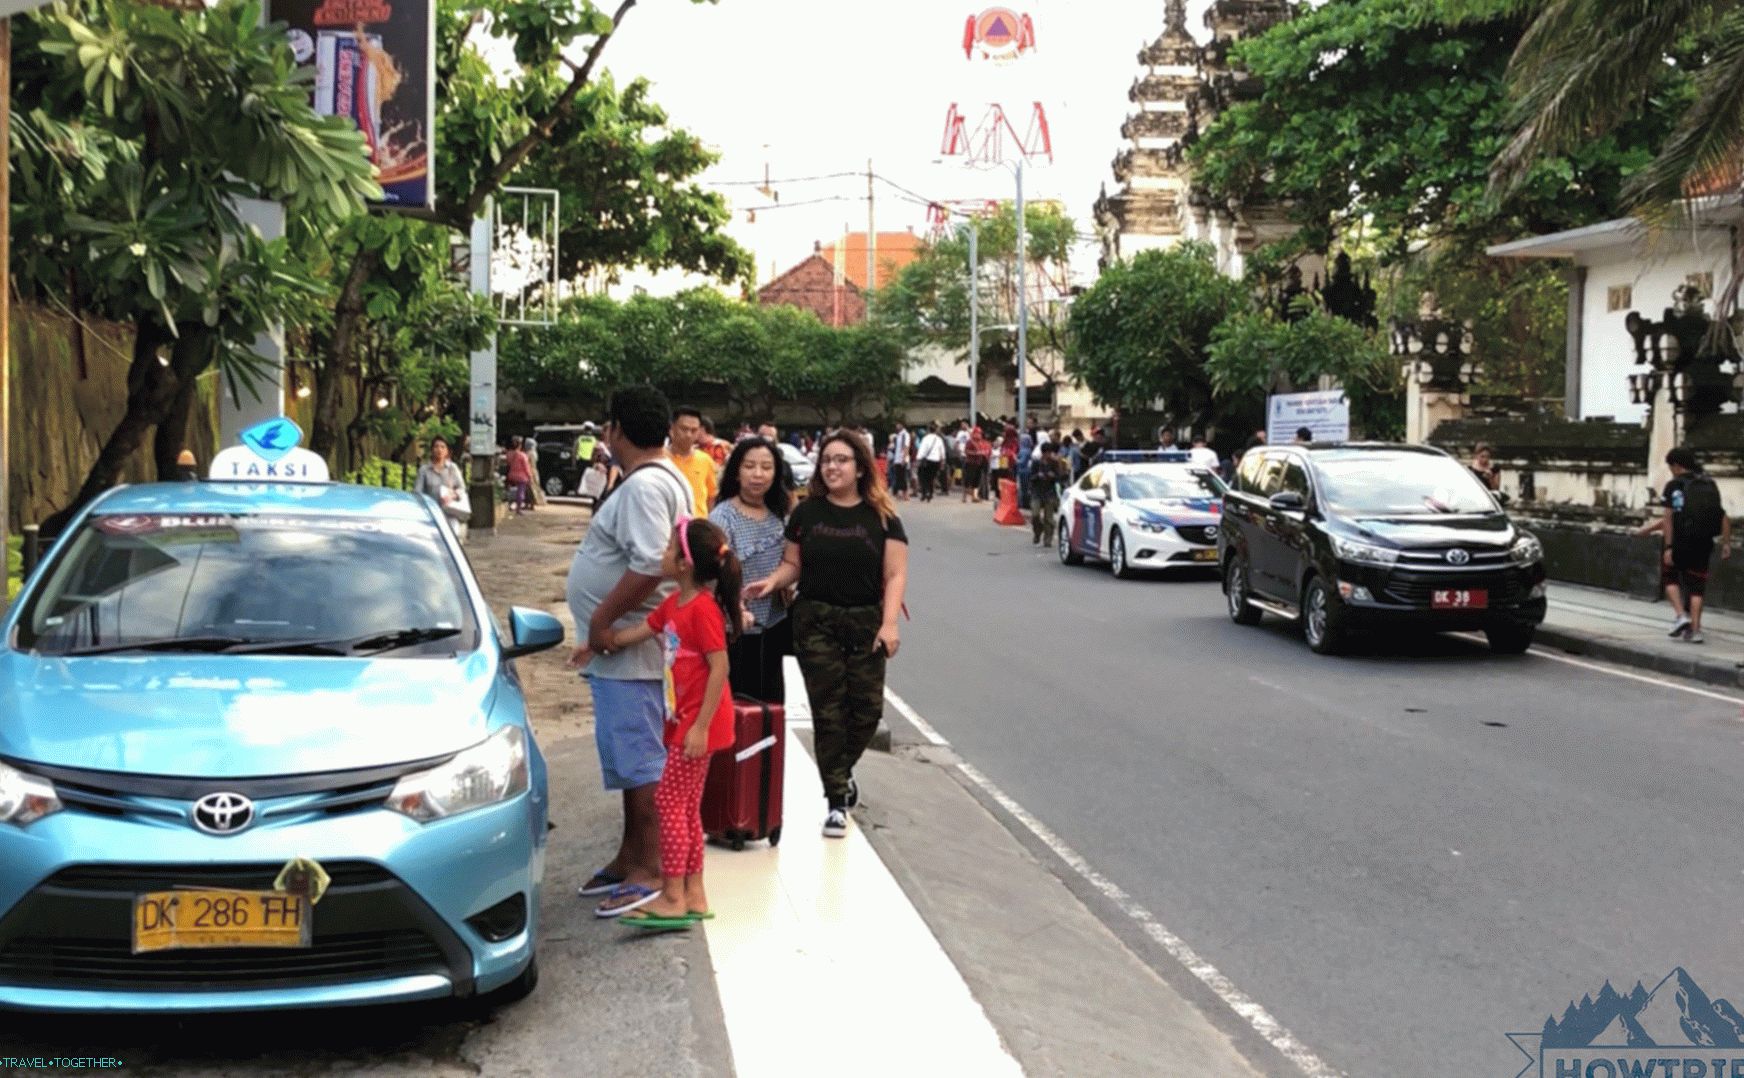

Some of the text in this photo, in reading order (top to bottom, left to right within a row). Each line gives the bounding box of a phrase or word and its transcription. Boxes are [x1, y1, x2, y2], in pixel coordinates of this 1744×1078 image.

[232, 462, 307, 477] TAKSI
[160, 516, 229, 527] BLUE
[1434, 590, 1450, 603] DK
[143, 896, 300, 931] DK 286 FH
